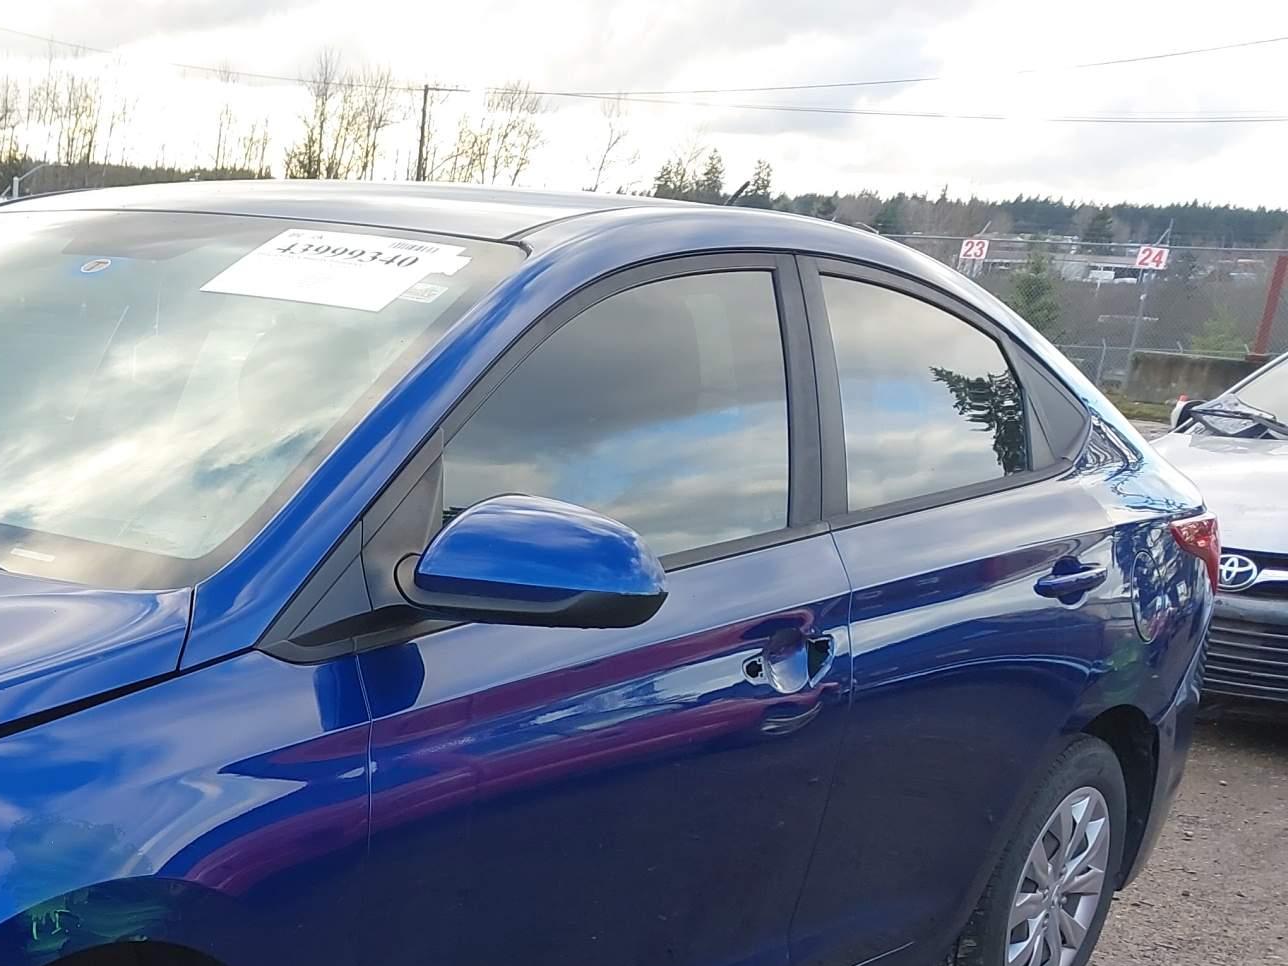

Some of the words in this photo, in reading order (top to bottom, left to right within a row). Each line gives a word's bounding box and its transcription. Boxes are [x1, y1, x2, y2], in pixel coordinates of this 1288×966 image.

[277, 242, 420, 268] 43999340
[962, 240, 986, 258] 23
[1138, 248, 1163, 267] 24
